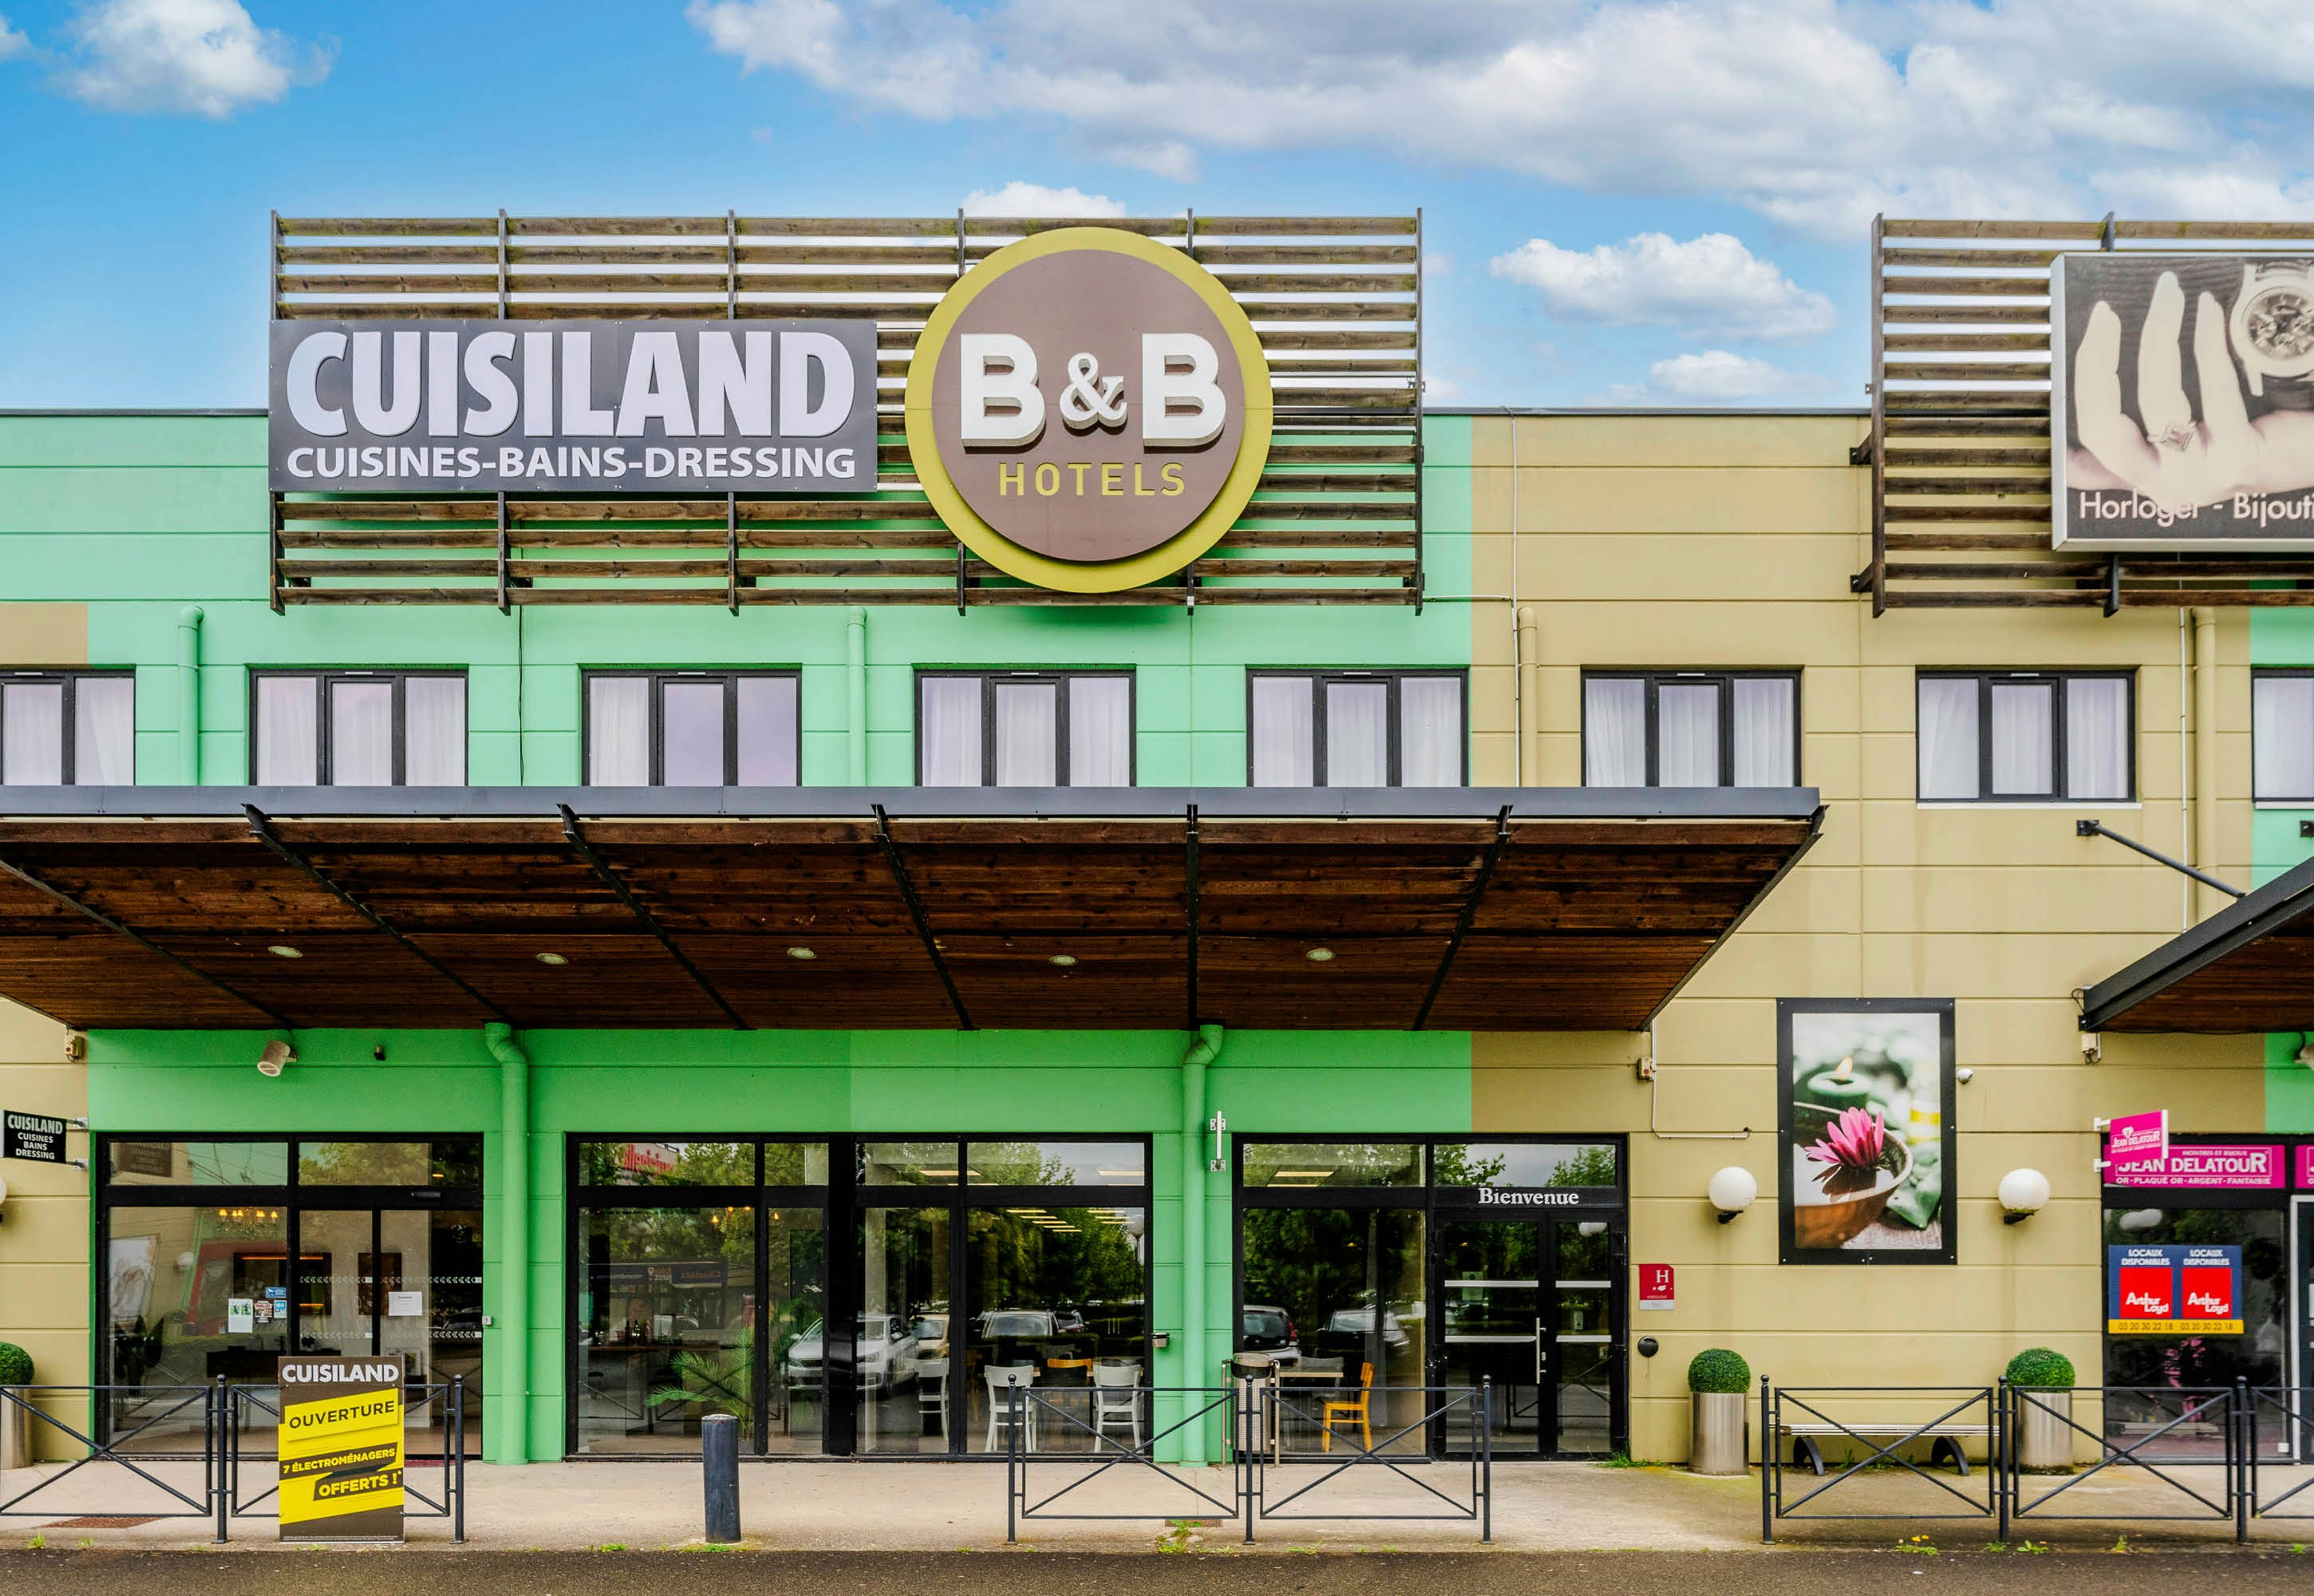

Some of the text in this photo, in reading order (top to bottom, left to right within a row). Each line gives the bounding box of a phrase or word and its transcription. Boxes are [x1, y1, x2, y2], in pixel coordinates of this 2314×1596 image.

[286, 330, 855, 437] CUISILAND
[961, 333, 1226, 447] B&B
[999, 462, 1185, 496] HOTELS
[7, 1114, 63, 1135] CUISILAND
[18, 1132, 53, 1144] CUISINES
[23, 1141, 48, 1151] BAINS
[15, 1148, 55, 1159] DRESSING
[2171, 1153, 2266, 1173] DELATOUR
[1478, 1187, 1579, 1206] Bienvenue
[1656, 1270, 1669, 1283] H
[282, 1364, 399, 1382] CUISILAND
[290, 1400, 394, 1428] OUVERTURE
[283, 1448, 396, 1474] 7 ÉLECTROMÉNAGERS
[319, 1474, 389, 1497] OFFERTS
